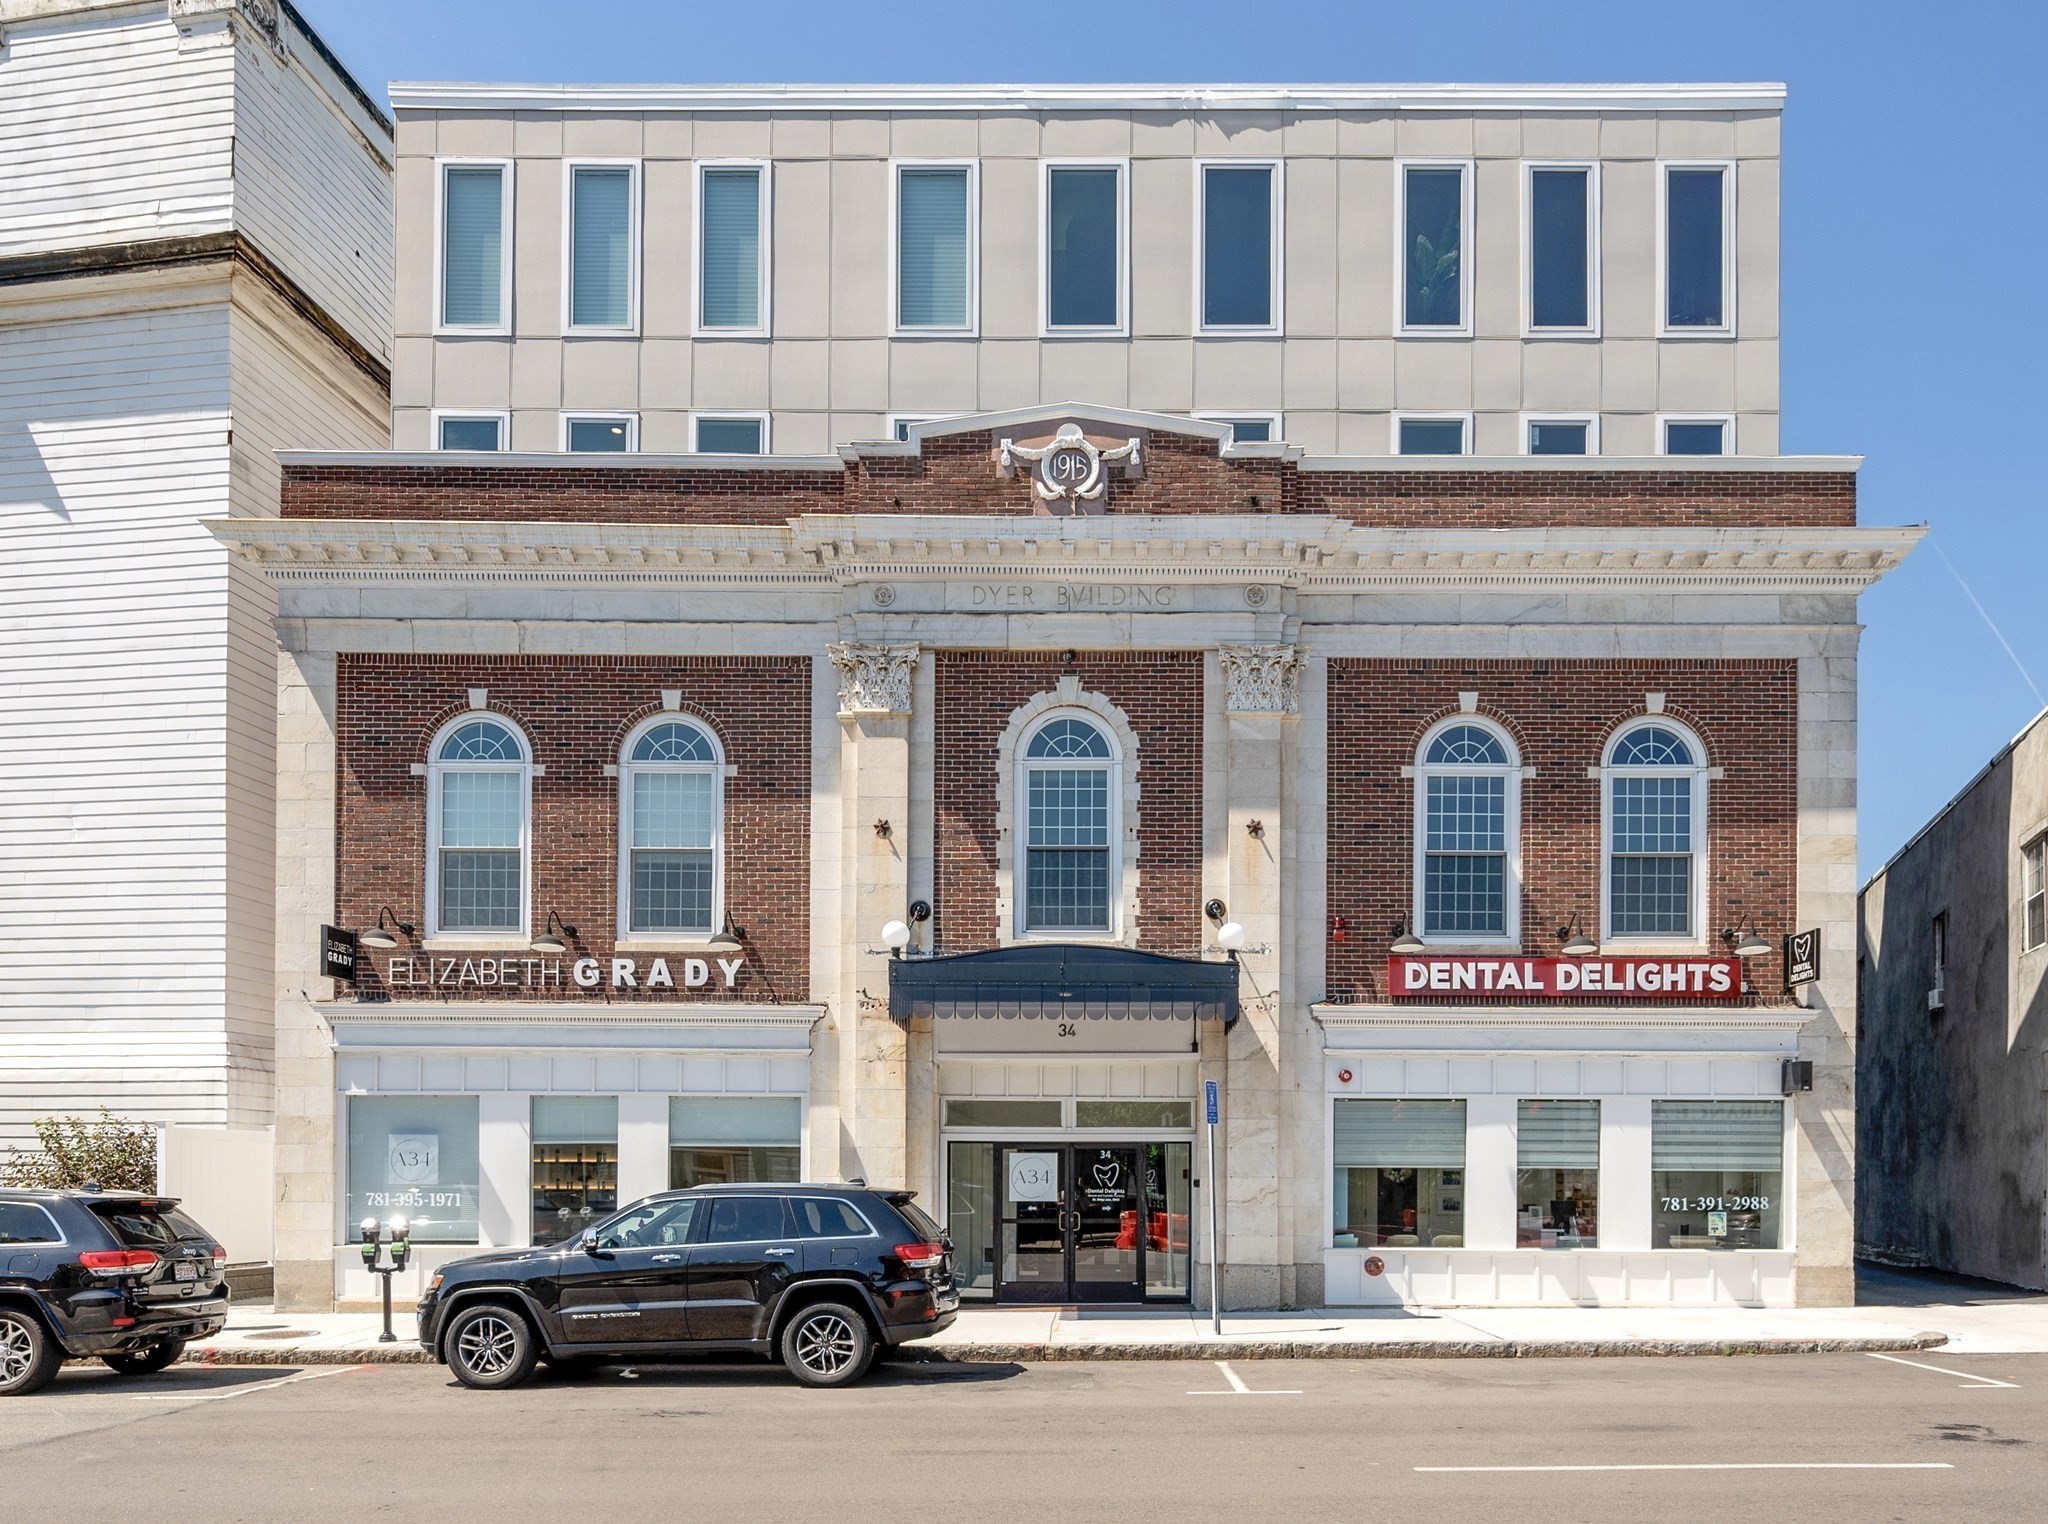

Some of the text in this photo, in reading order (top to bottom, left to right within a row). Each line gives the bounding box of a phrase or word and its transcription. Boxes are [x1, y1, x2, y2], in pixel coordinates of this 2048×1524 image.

[1052, 454, 1088, 481] 1915
[972, 585, 1171, 606] DYER BVILDING
[328, 940, 352, 954] ELIZABETH
[327, 951, 353, 967] GRADY
[388, 957, 744, 987] ELIZABETH GRADY
[1793, 962, 1811, 973] DENTAL
[1404, 961, 1731, 992] DENTAL DELIGHTS
[1791, 970, 1813, 982] DELIGHTS
[1058, 1023, 1076, 1037] 34
[394, 1151, 429, 1167] A34
[1099, 1150, 1111, 1159] 34
[1014, 1169, 1049, 1184] A34
[365, 1192, 461, 1207] 781-395-1971
[1660, 1196, 1769, 1212] 781-391-2988
